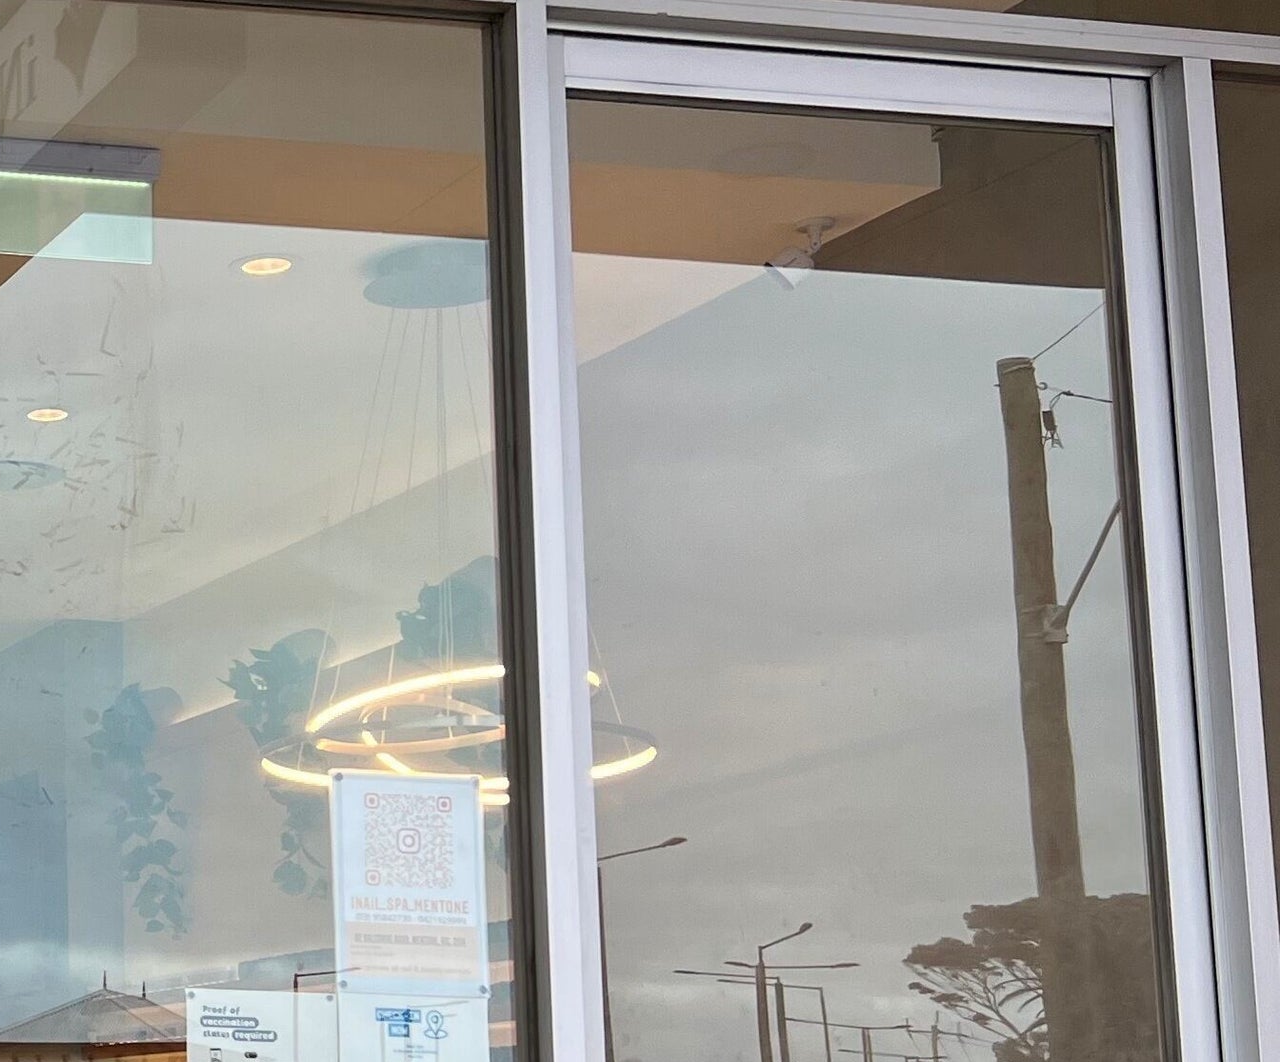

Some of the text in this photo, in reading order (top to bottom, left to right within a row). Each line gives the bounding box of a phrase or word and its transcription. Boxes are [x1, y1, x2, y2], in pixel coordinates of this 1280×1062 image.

[202, 1005, 241, 1014] Proof of
[202, 1018, 256, 1027] vaccination
[234, 1031, 275, 1041] required
